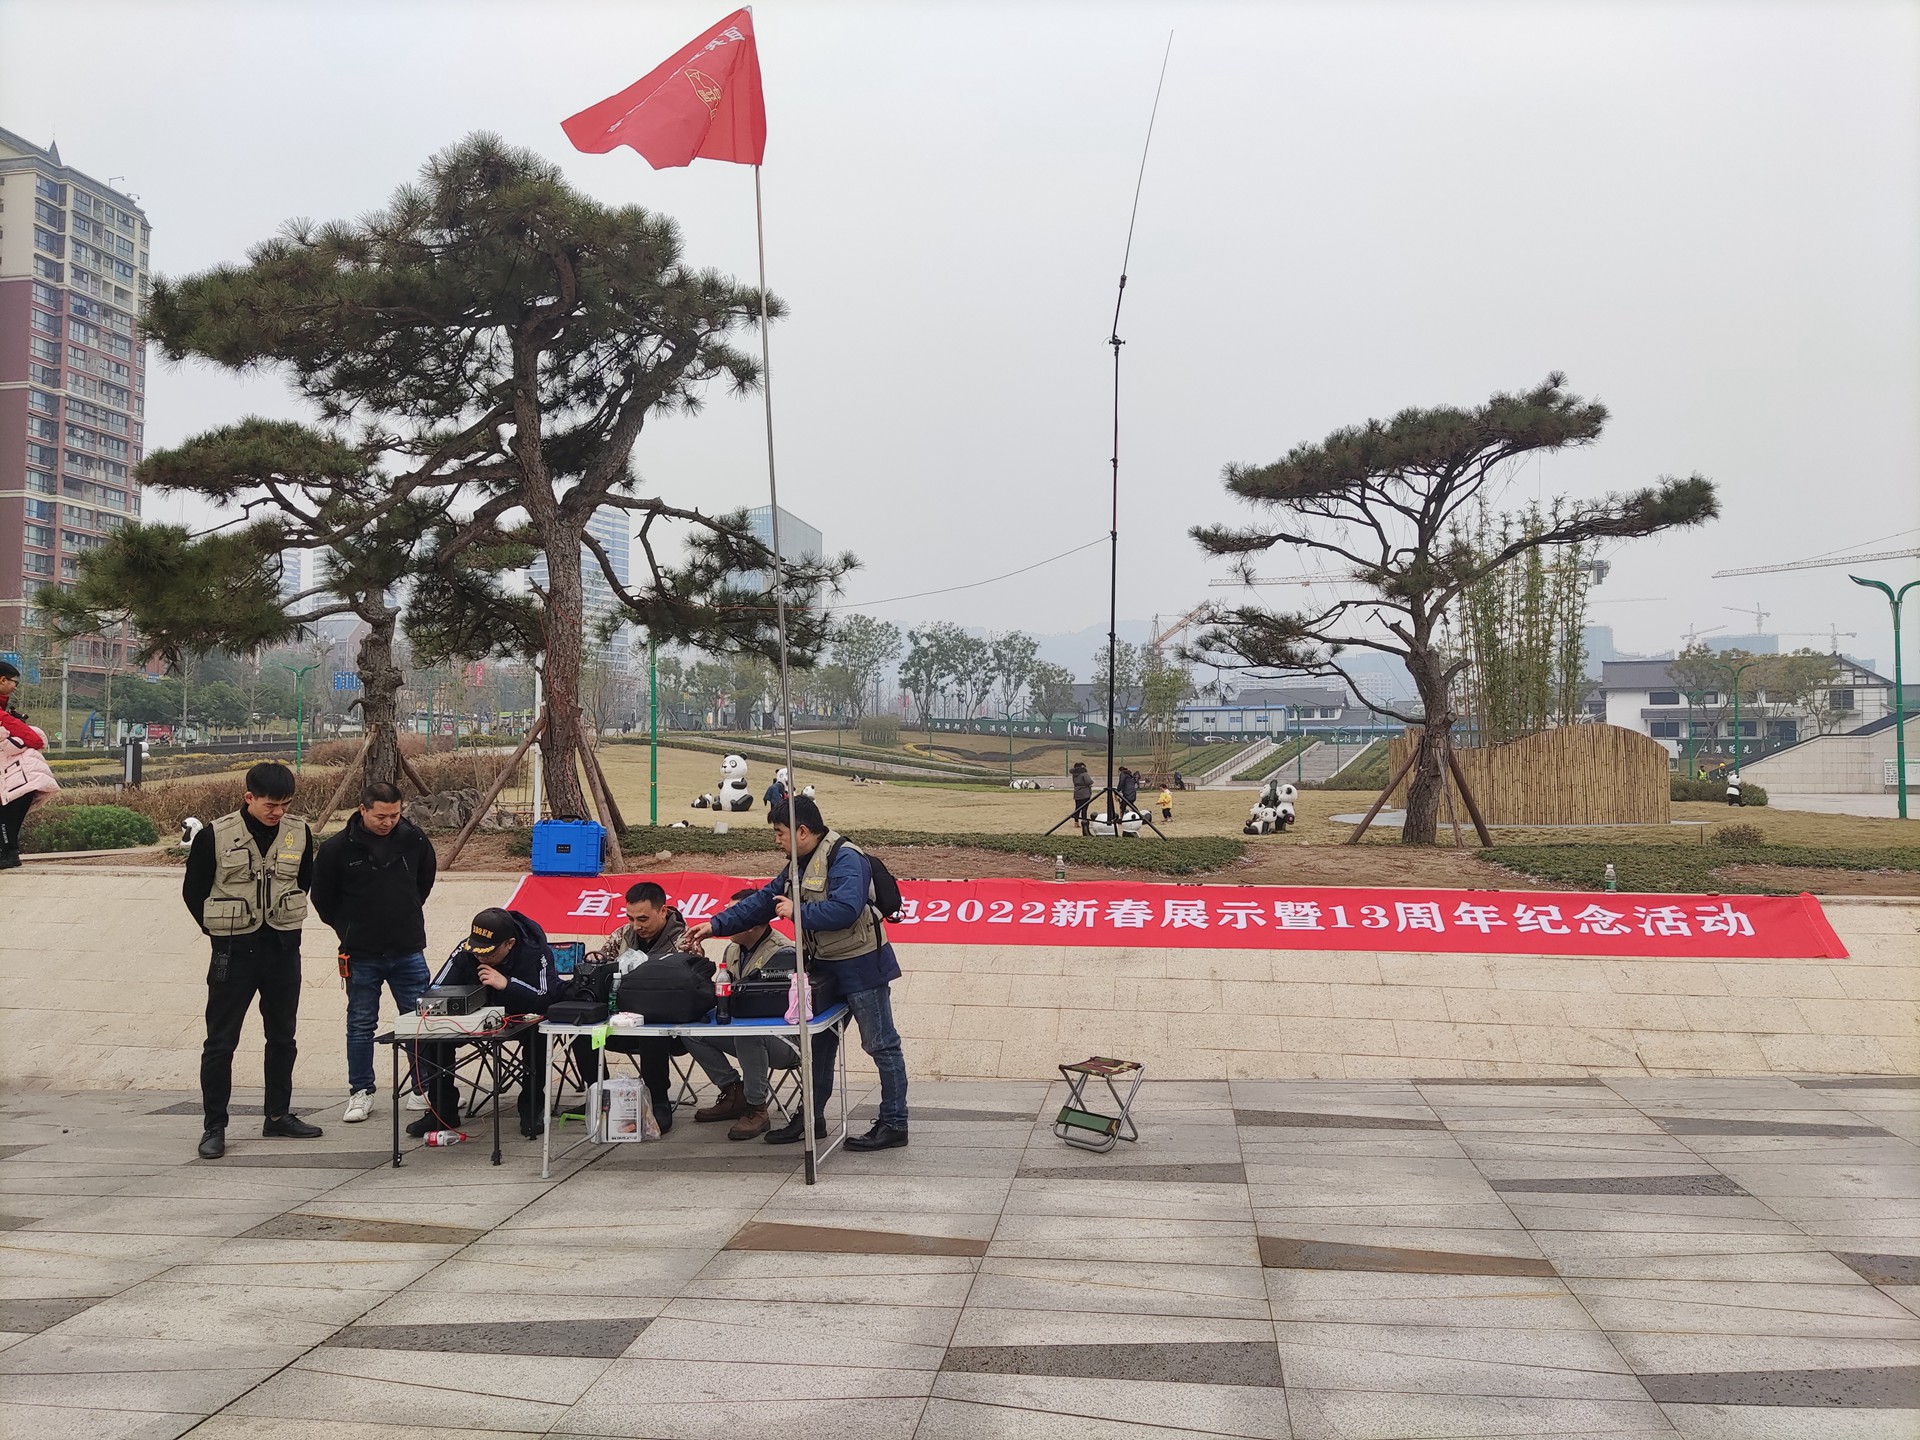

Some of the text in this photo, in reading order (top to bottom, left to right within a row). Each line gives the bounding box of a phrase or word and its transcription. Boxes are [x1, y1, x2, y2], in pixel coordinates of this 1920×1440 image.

[566, 888, 1757, 938] 宜业电2022新春展示暨13周年纪念活动
